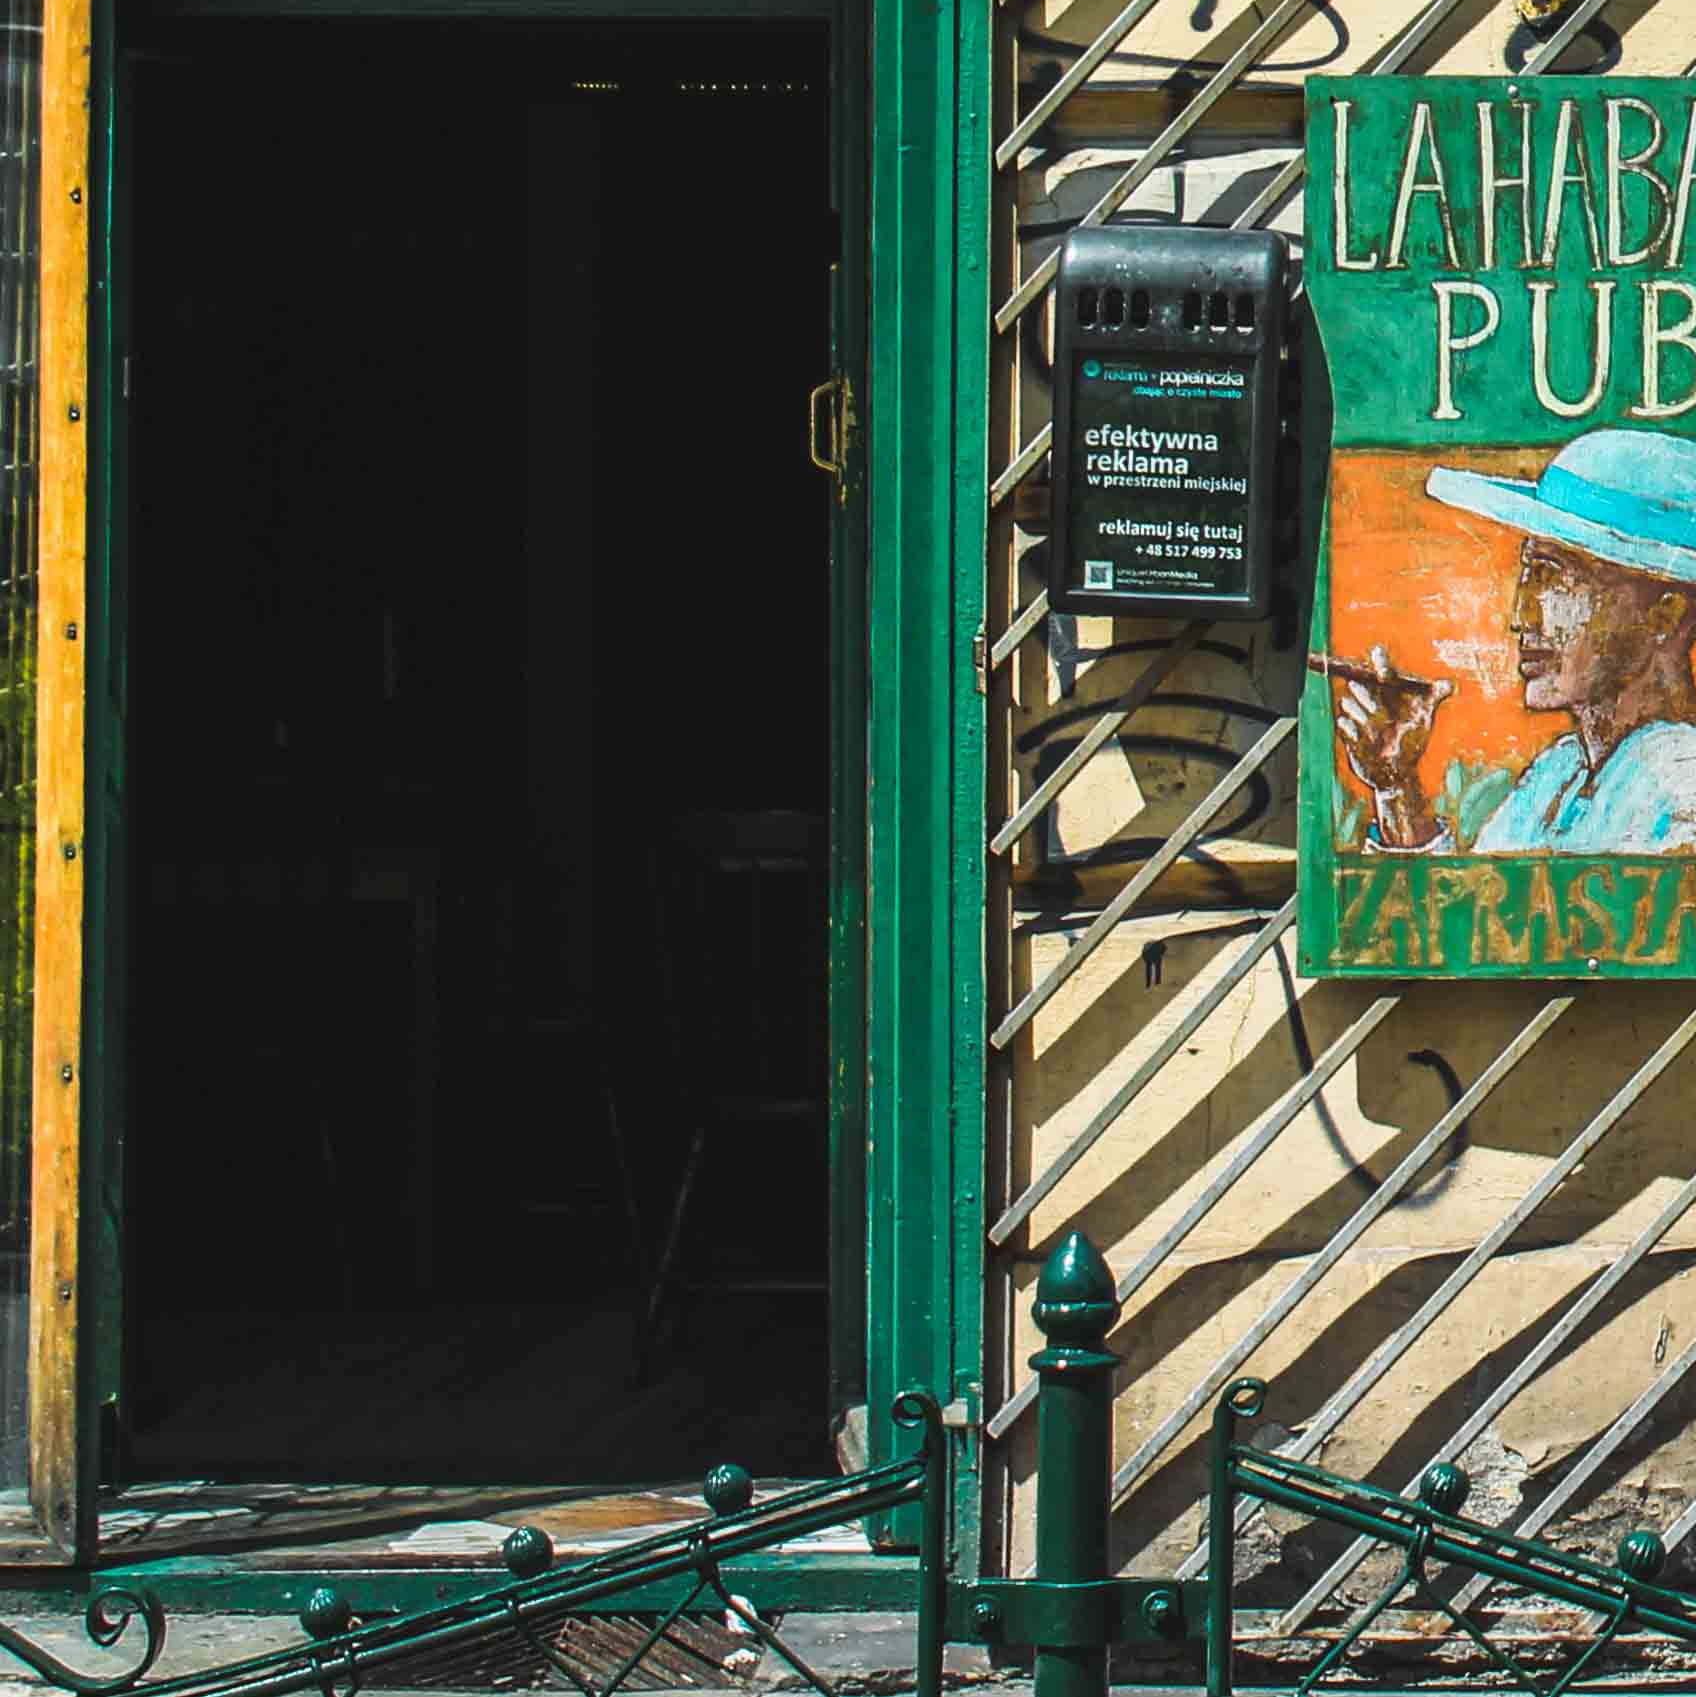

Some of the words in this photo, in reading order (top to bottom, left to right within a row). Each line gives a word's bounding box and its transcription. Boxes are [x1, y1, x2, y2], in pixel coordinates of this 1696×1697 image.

[1331, 99, 1461, 272] LA
[1084, 423, 1220, 454] efektywna
[1086, 449, 1190, 475] reklama
[1087, 475, 1101, 485] w
[1103, 474, 1181, 489] przestrzeni
[1184, 476, 1248, 495] miejskiej
[1098, 519, 1173, 540] reklamuj
[1175, 521, 1201, 542] się
[1203, 523, 1244, 544] tutaj
[1145, 544, 1163, 556] 48
[1164, 544, 1189, 558] 517
[1191, 545, 1217, 559] 499
[1218, 547, 1243, 560] 753
